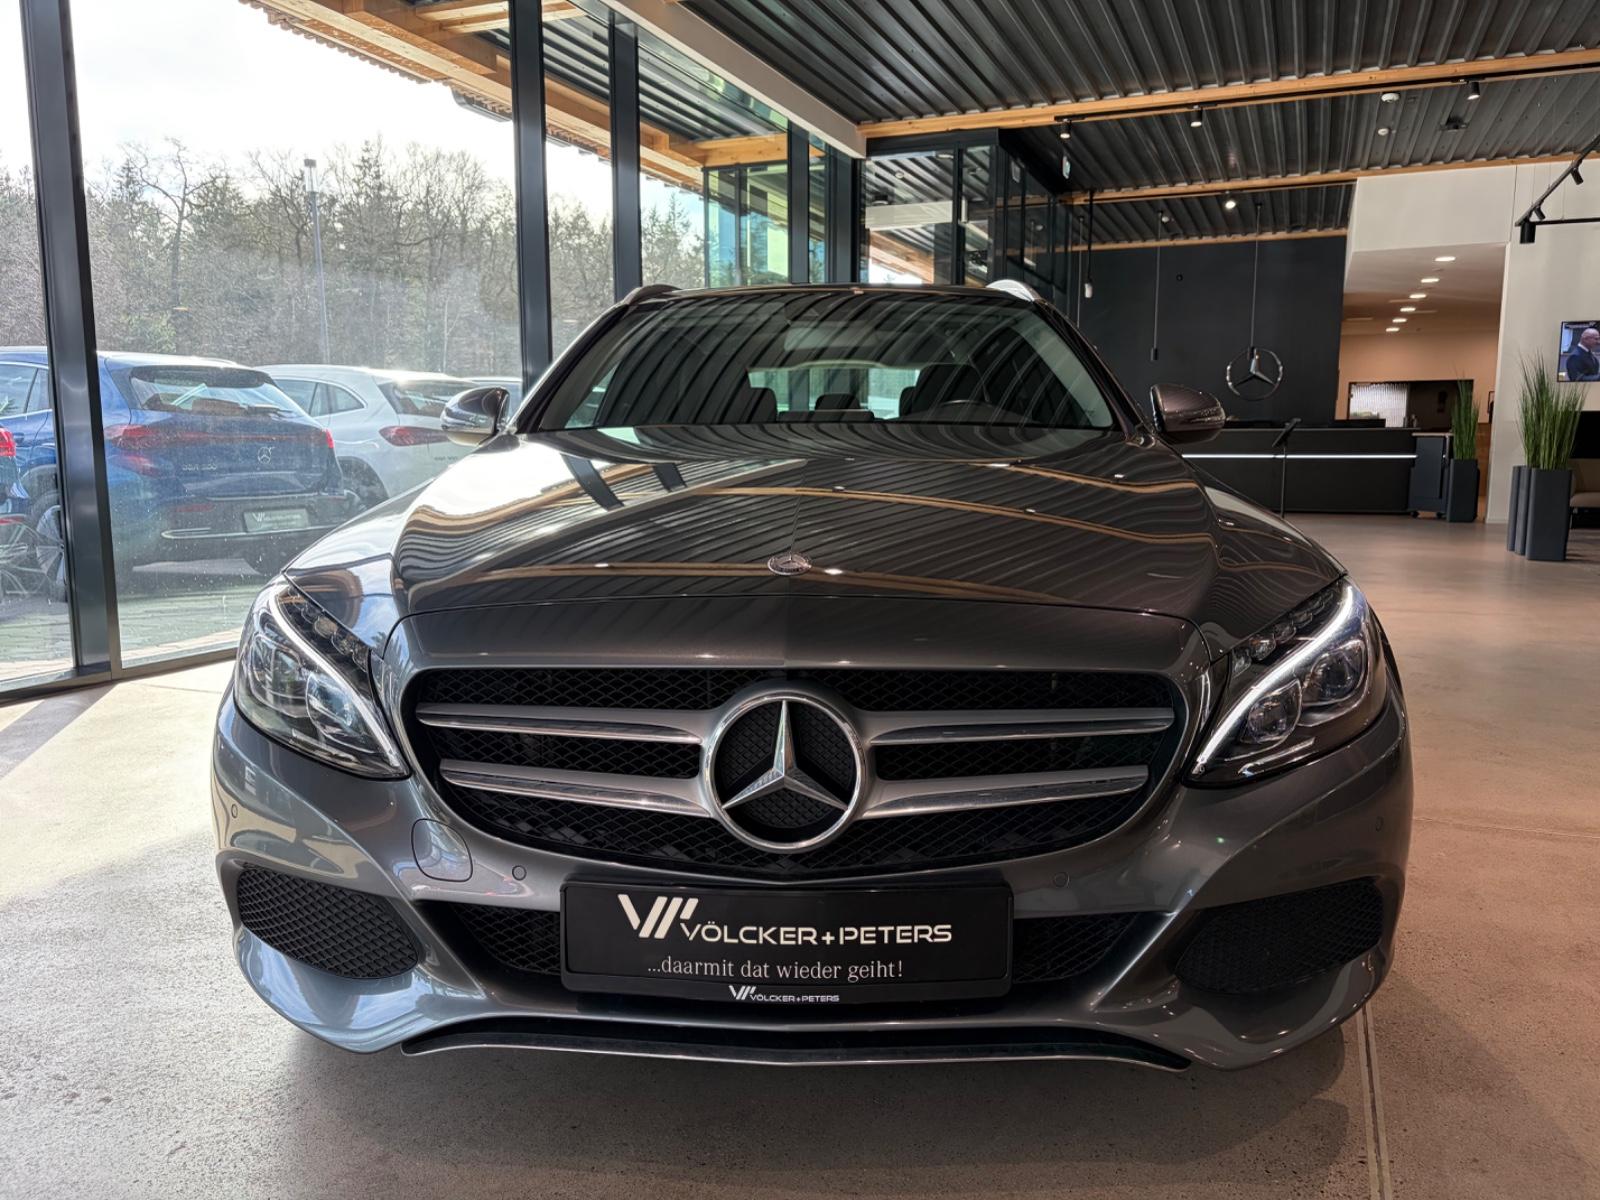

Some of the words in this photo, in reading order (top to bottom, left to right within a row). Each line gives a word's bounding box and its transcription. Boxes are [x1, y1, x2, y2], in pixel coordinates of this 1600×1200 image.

[740, 960, 770, 979] dat
[776, 961, 842, 979] wieder
[847, 960, 903, 983] geiht!
